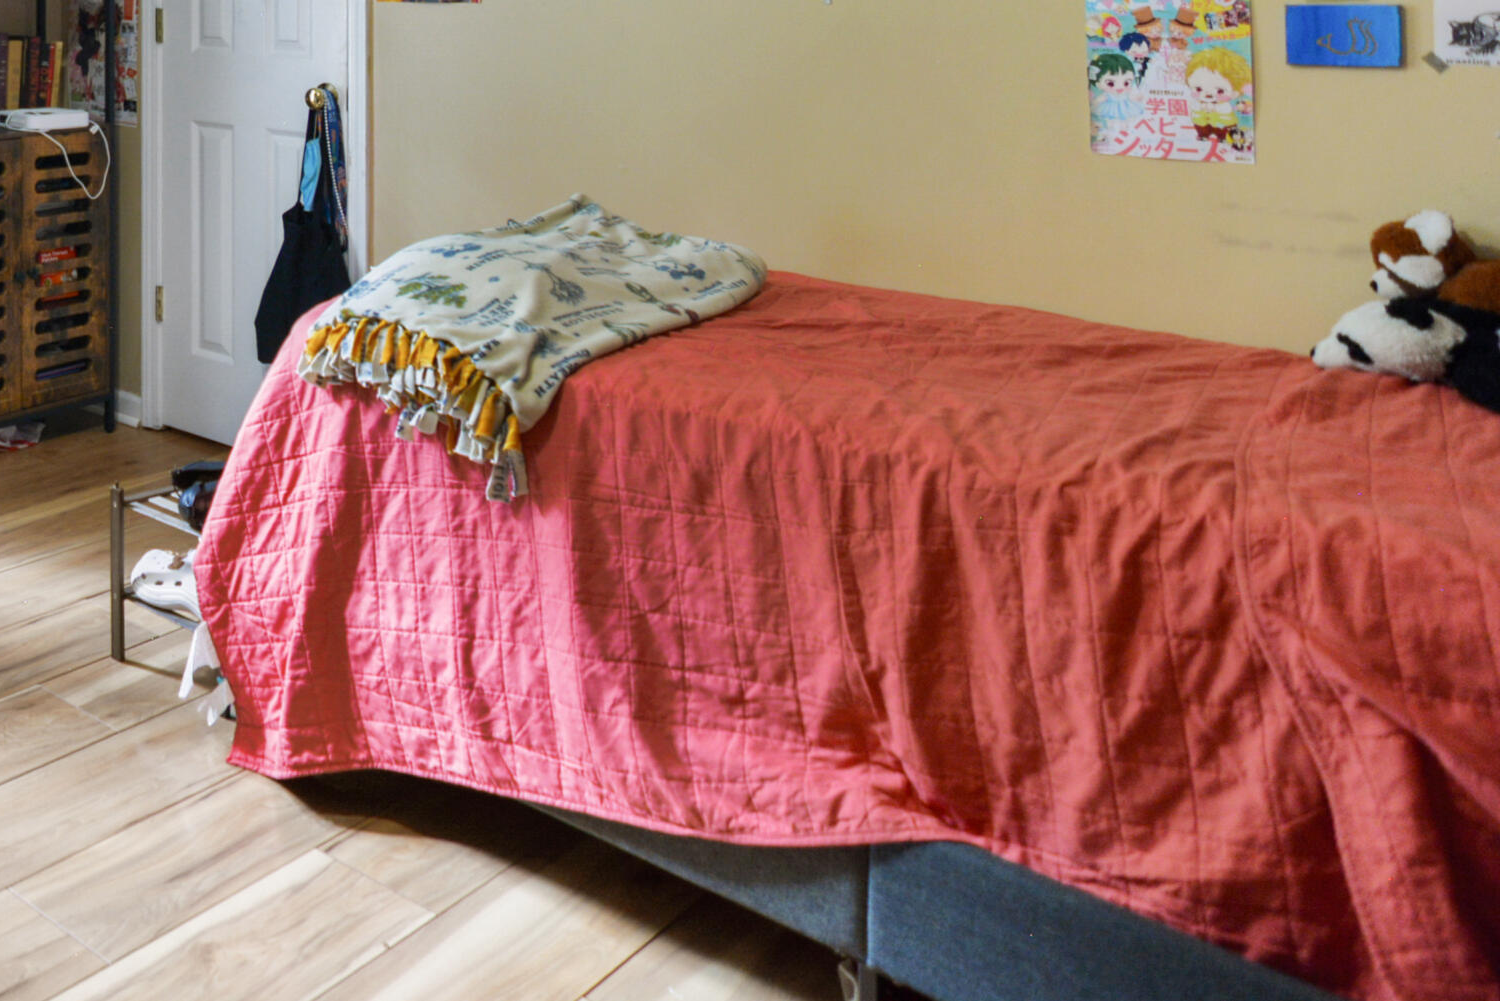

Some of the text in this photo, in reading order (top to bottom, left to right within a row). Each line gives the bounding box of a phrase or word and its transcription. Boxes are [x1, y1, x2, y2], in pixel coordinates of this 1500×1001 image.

[1145, 98, 1189, 116] 学園
[1134, 117, 1197, 137] ベビー
[1114, 130, 1228, 162] シッターズ
